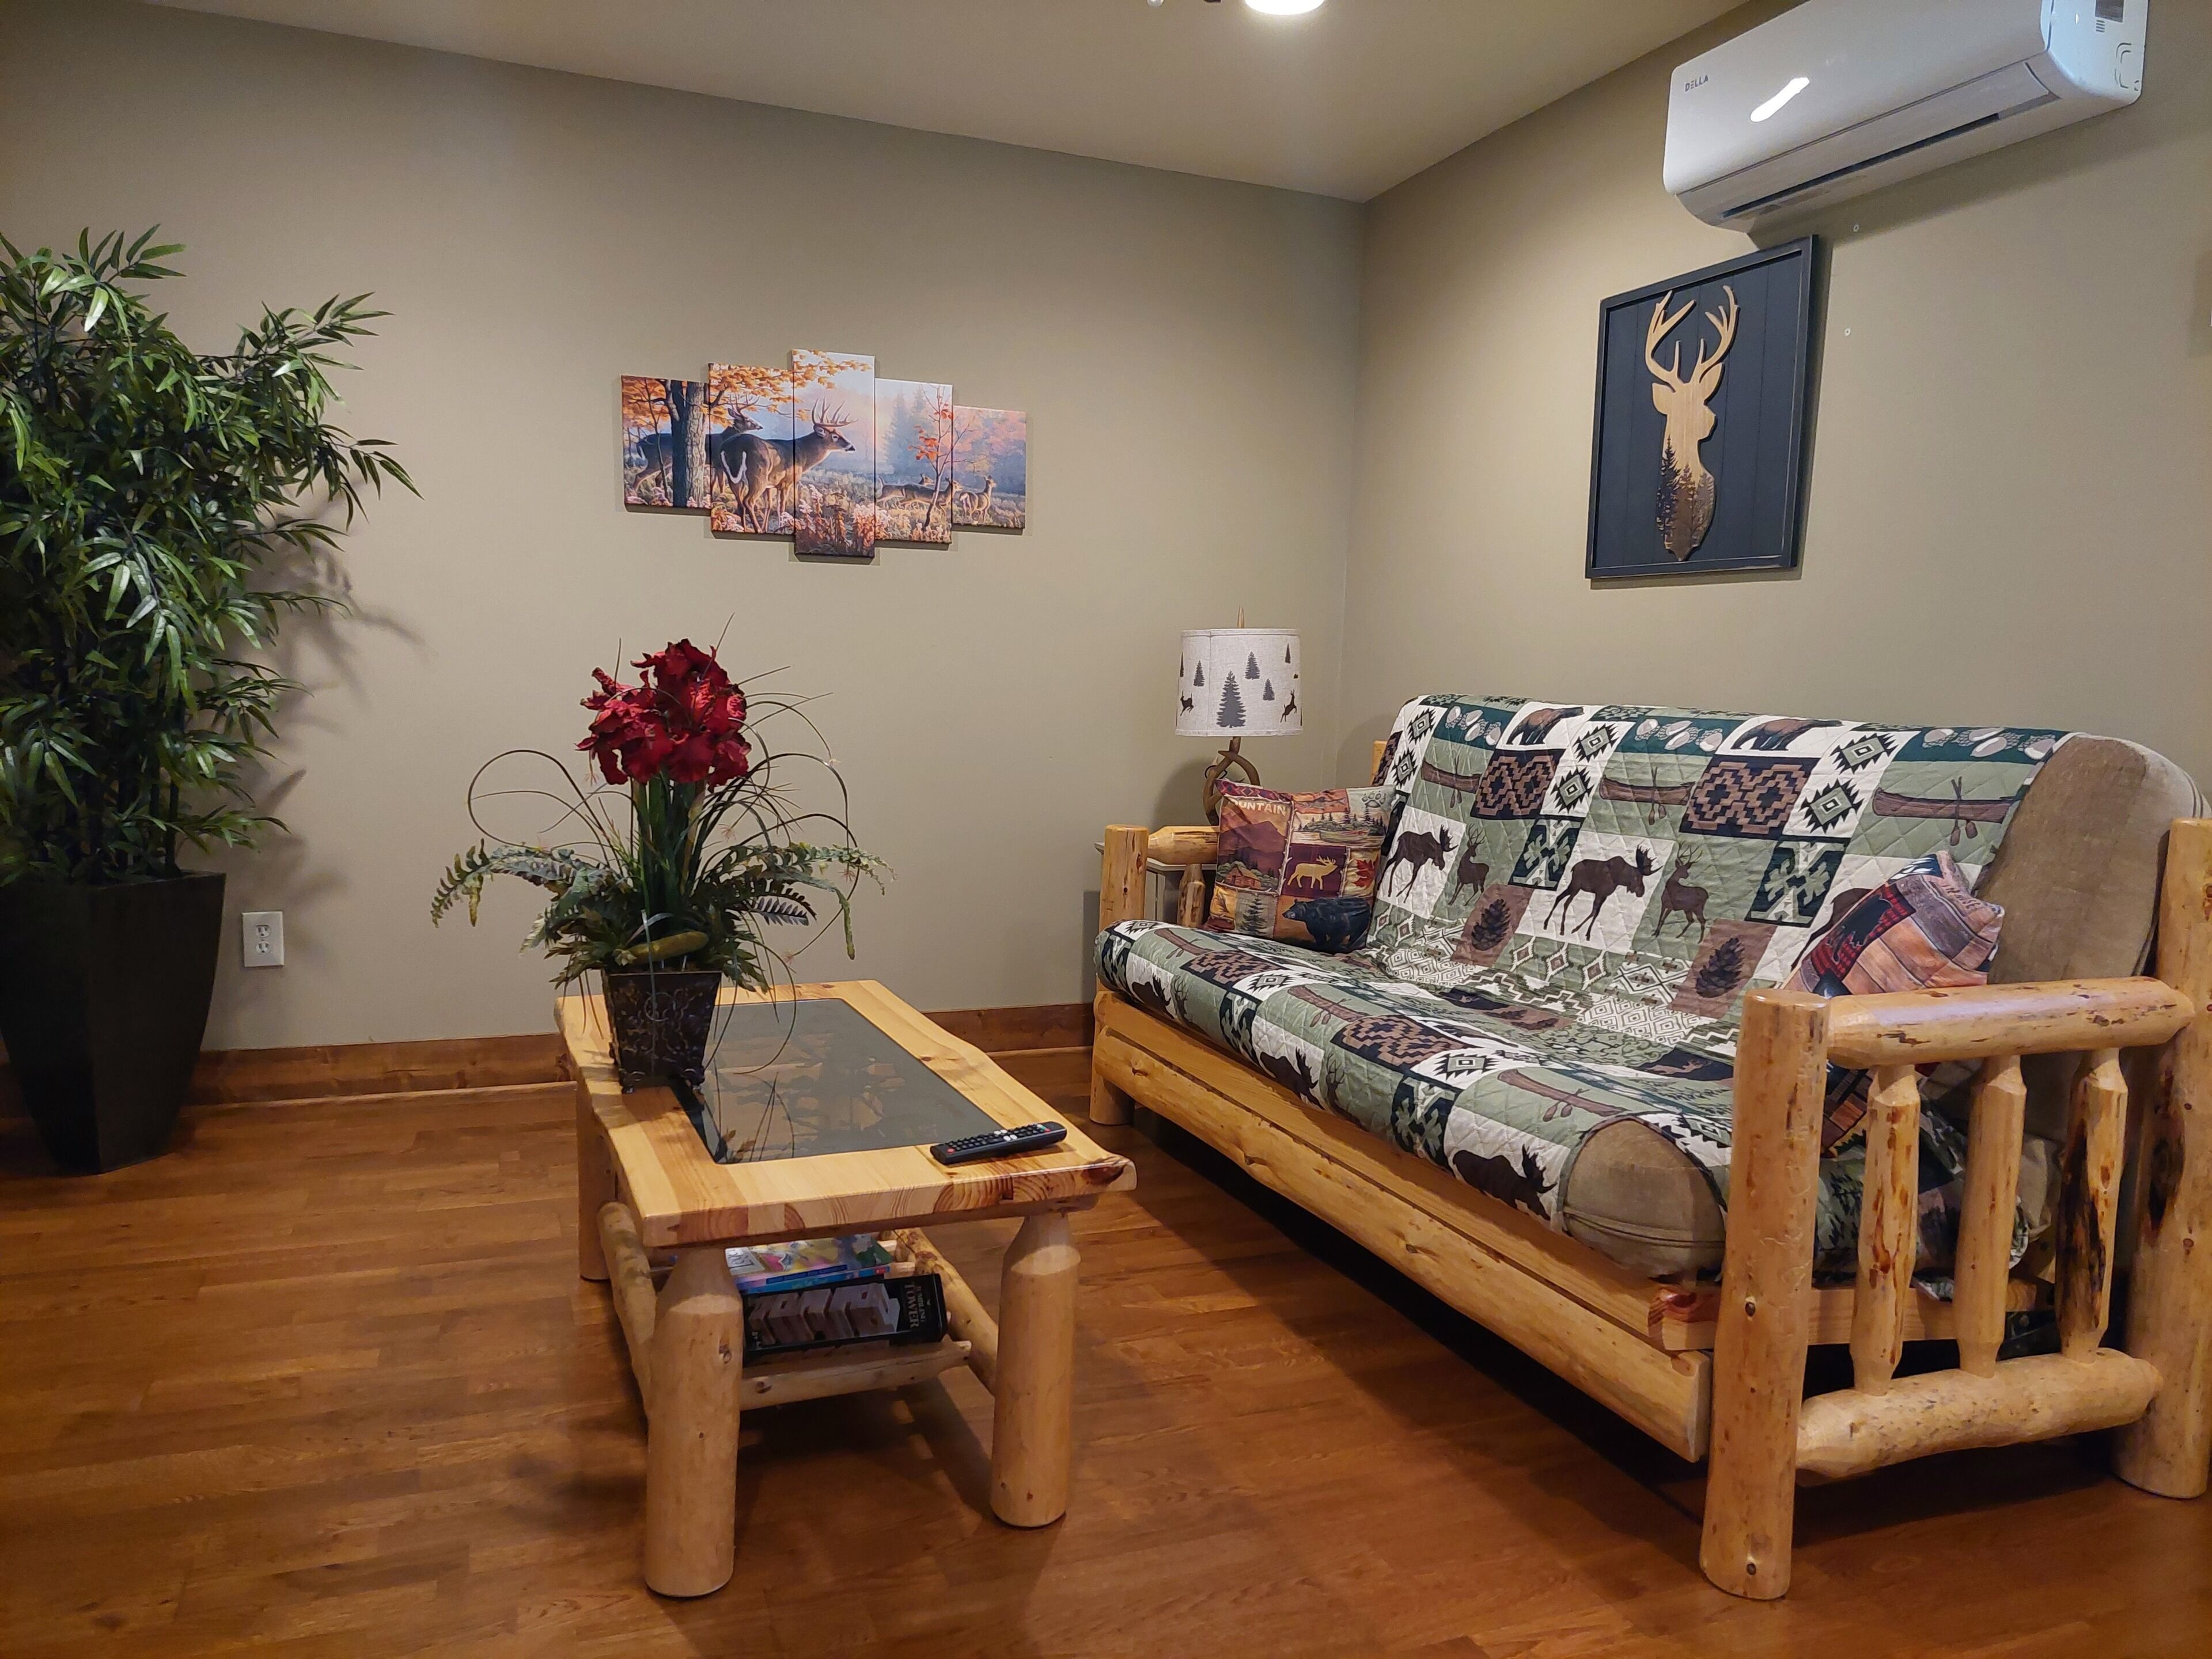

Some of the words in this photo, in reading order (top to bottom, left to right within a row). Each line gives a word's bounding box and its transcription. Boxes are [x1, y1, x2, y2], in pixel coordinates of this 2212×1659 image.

[1684, 75, 1709, 92] DELLA
[1227, 797, 1286, 816] UNTAIN
[904, 1282, 919, 1328] TOWER
